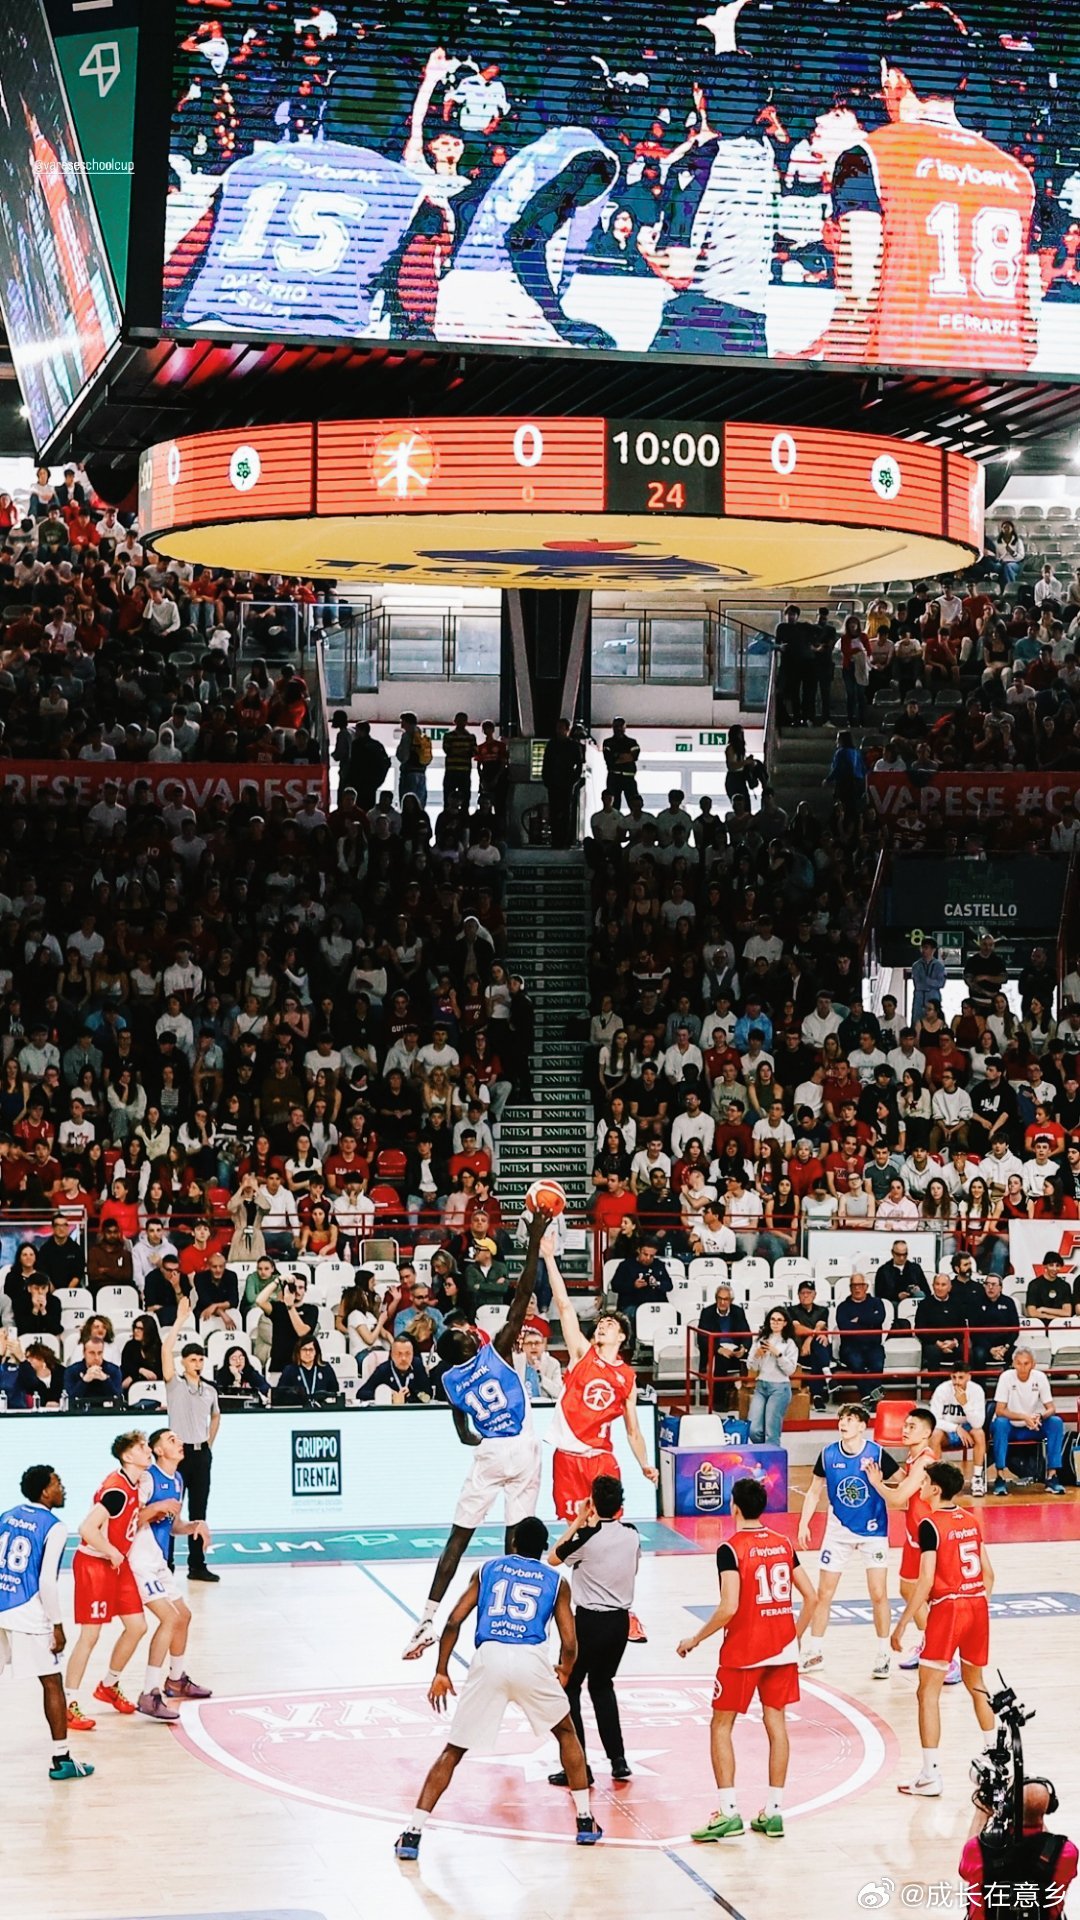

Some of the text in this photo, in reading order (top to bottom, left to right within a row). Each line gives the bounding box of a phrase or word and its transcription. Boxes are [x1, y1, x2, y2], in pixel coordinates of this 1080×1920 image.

[219, 181, 369, 276] 15
[926, 201, 1022, 302] 18
[513, 424, 542, 467] 0
[612, 431, 720, 467] 10:00
[771, 432, 797, 474] 0
[168, 445, 180, 486] 0
[647, 481, 684, 509] 24
[944, 904, 1017, 917] CASTELLO
[502, 1127, 530, 1136] INTESA
[500, 1146, 529, 1155] INTESA
[501, 1163, 530, 1172] INTESA
[500, 1200, 524, 1210] INTES
[331, 1263, 340, 1271] 19
[374, 1263, 384, 1271] 20
[74, 1311, 85, 1319] 20
[177, 1334, 188, 1342] 24
[225, 1333, 235, 1341] 25
[146, 1383, 157, 1391] 24
[464, 1378, 508, 1422] 19
[295, 1436, 338, 1458] GRUPPO
[296, 1467, 338, 1488] TRENTA
[699, 1482, 719, 1491] LBA
[866, 1518, 878, 1531] 6
[0, 1531, 31, 1573] 18
[821, 1549, 831, 1564] 6
[958, 1540, 982, 1579] 5
[145, 1580, 165, 1596] 10
[754, 1562, 792, 1605] 18
[488, 1579, 542, 1622] 15
[90, 1601, 107, 1619] 13
[491, 1620, 527, 1633] DAVERIO
